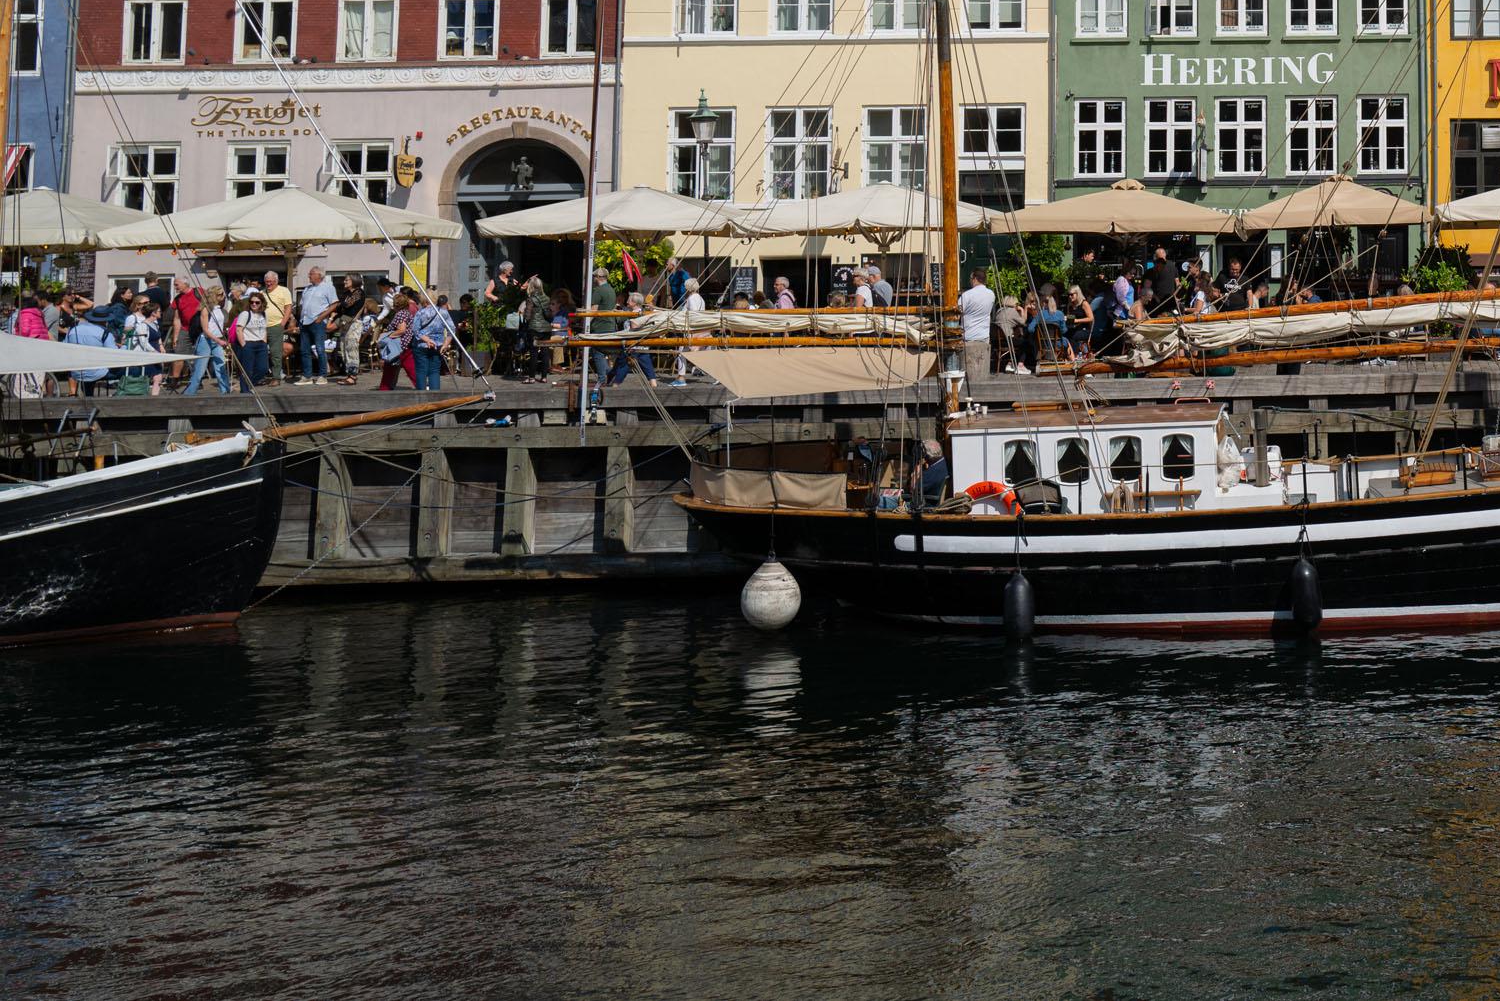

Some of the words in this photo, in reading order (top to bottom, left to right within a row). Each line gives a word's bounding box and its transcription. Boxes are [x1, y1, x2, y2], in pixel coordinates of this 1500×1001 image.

[1140, 52, 1338, 86] HEERING
[197, 130, 224, 138] THE
[231, 129, 287, 138] TINDER
[457, 106, 583, 139] RESTAURANT
